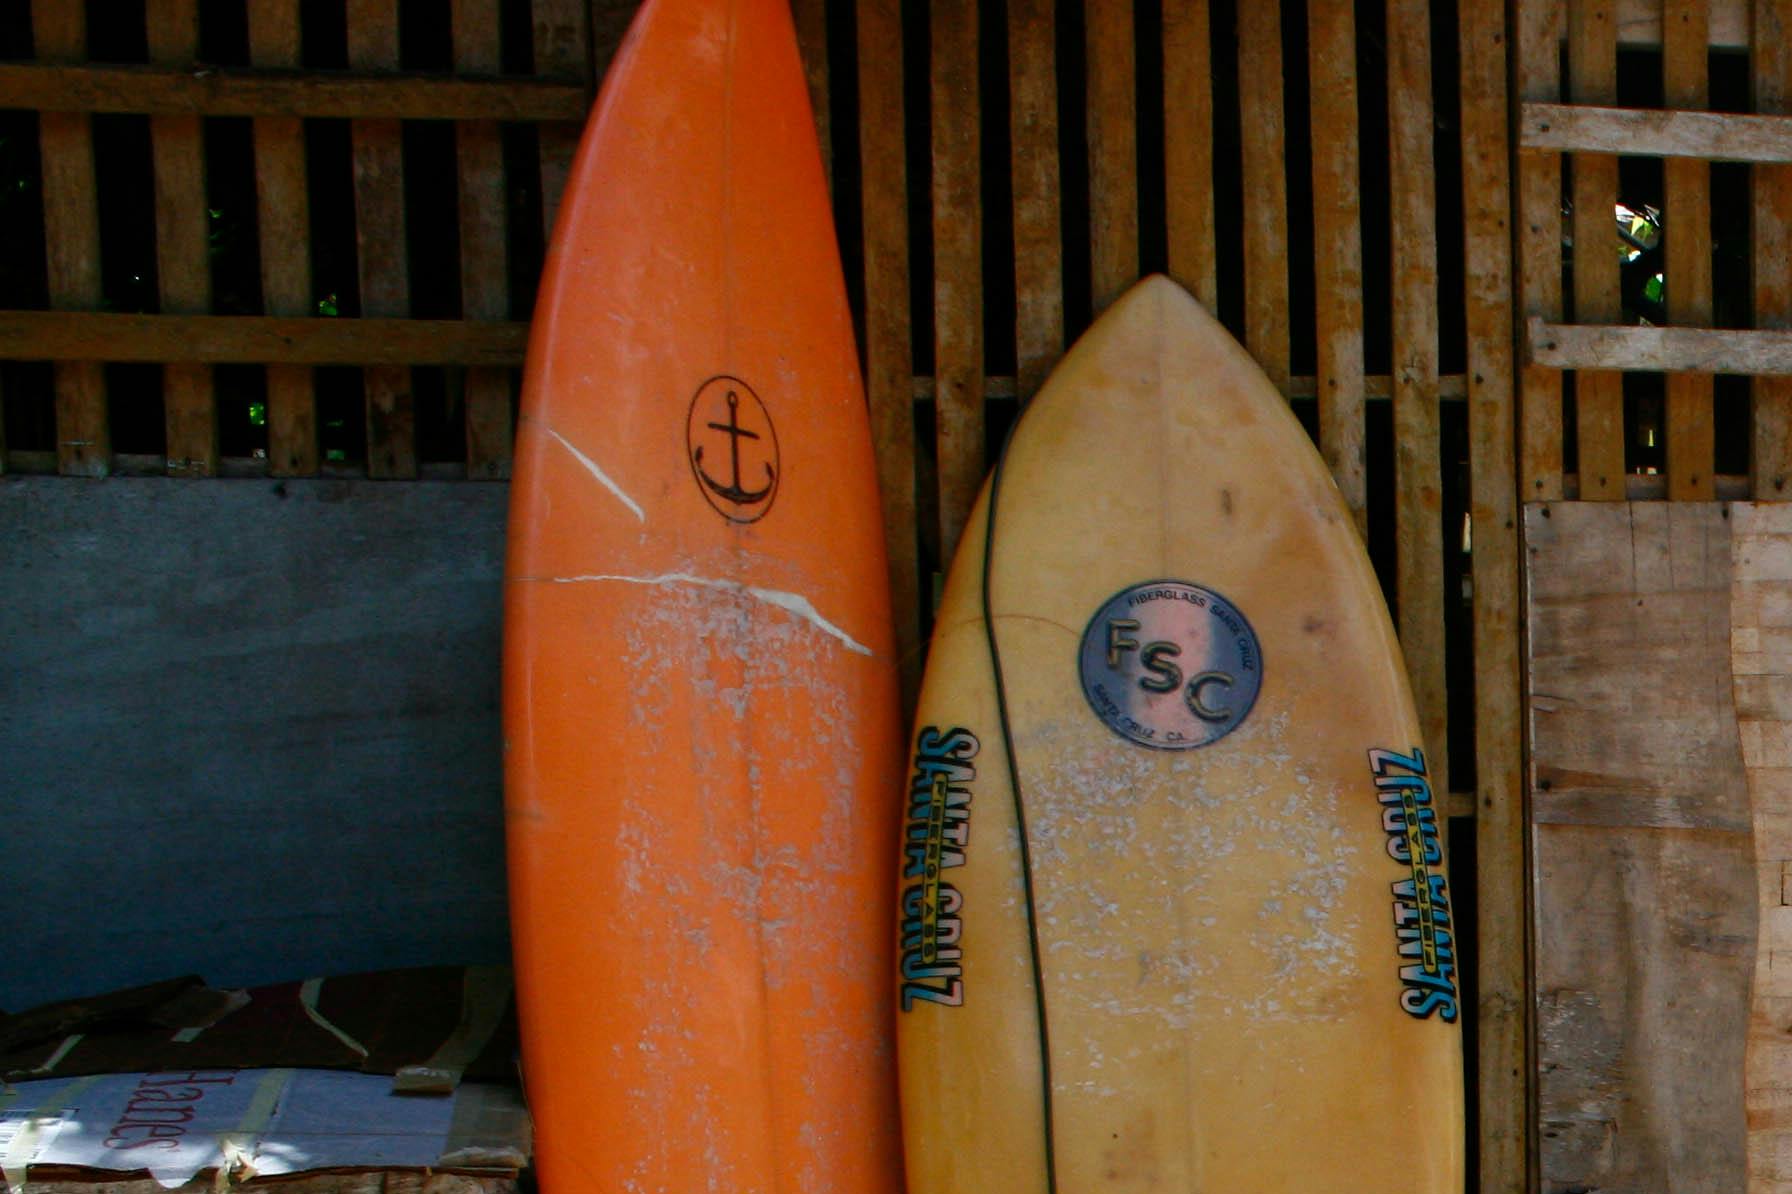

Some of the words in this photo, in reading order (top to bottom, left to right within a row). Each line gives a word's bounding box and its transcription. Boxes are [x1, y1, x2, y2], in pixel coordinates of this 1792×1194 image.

[906, 727, 980, 880] SANTA
[1368, 748, 1443, 865] CRUZ
[901, 882, 964, 1012] CRUZ
[1391, 873, 1457, 1023] SANTA
